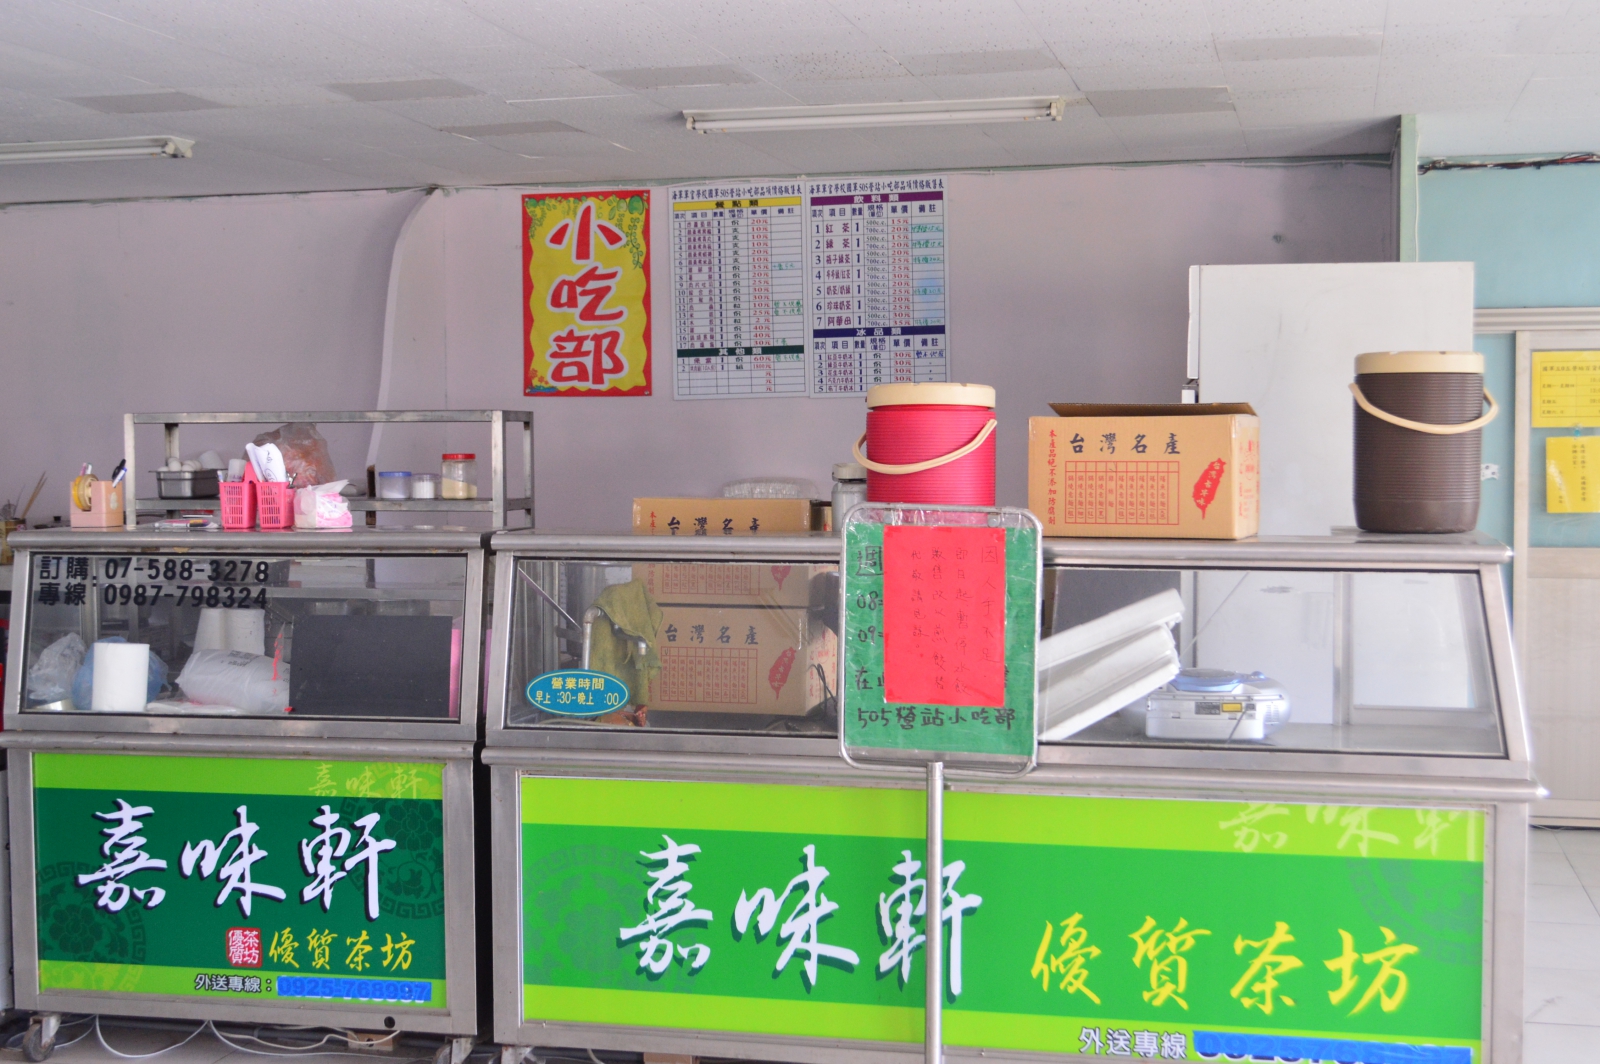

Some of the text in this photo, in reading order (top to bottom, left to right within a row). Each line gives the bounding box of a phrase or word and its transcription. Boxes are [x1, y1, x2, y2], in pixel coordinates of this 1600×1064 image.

[716, 200, 758, 208] 餐點類
[854, 193, 899, 204] 飲料類
[812, 210, 823, 218] 項次
[829, 208, 846, 217] 項目
[852, 207, 862, 216] 數量
[891, 205, 908, 214] 單價
[919, 204, 936, 213] 備註
[815, 223, 849, 233] 1 紅茶
[815, 238, 850, 249] 2 綠茶
[816, 256, 820, 264] 3
[816, 271, 821, 279] 4
[546, 202, 628, 388] 小吃部
[816, 285, 851, 295] 5 奶茶/奶綠
[816, 301, 851, 311] 6 珍珠奶茶
[817, 316, 852, 326] 7 阿華田
[856, 328, 901, 336] 冰品類
[814, 342, 825, 350] 項次
[832, 341, 848, 349] 項目
[855, 340, 865, 348] 數量
[893, 339, 910, 347] 單價
[921, 338, 938, 347] 備註
[1070, 432, 1181, 455] 台灣名產
[1196, 462, 1221, 506] 台灣古早味
[105, 557, 269, 583] 07-588-3278
[104, 584, 268, 609] 0987-798324
[664, 623, 758, 645] 台灣名產
[552, 677, 604, 690] 營業時間
[535, 691, 551, 704] 早上
[857, 706, 1015, 730] 505營站小吃部
[308, 762, 422, 799] 嘉味軒
[76, 798, 396, 921] 嘉味軒
[620, 834, 983, 996] 嘉味軒
[269, 927, 416, 972] 優質茶坊
[1031, 912, 1419, 1017] 優質茶坊
[1078, 1027, 1186, 1059] 外送專線
